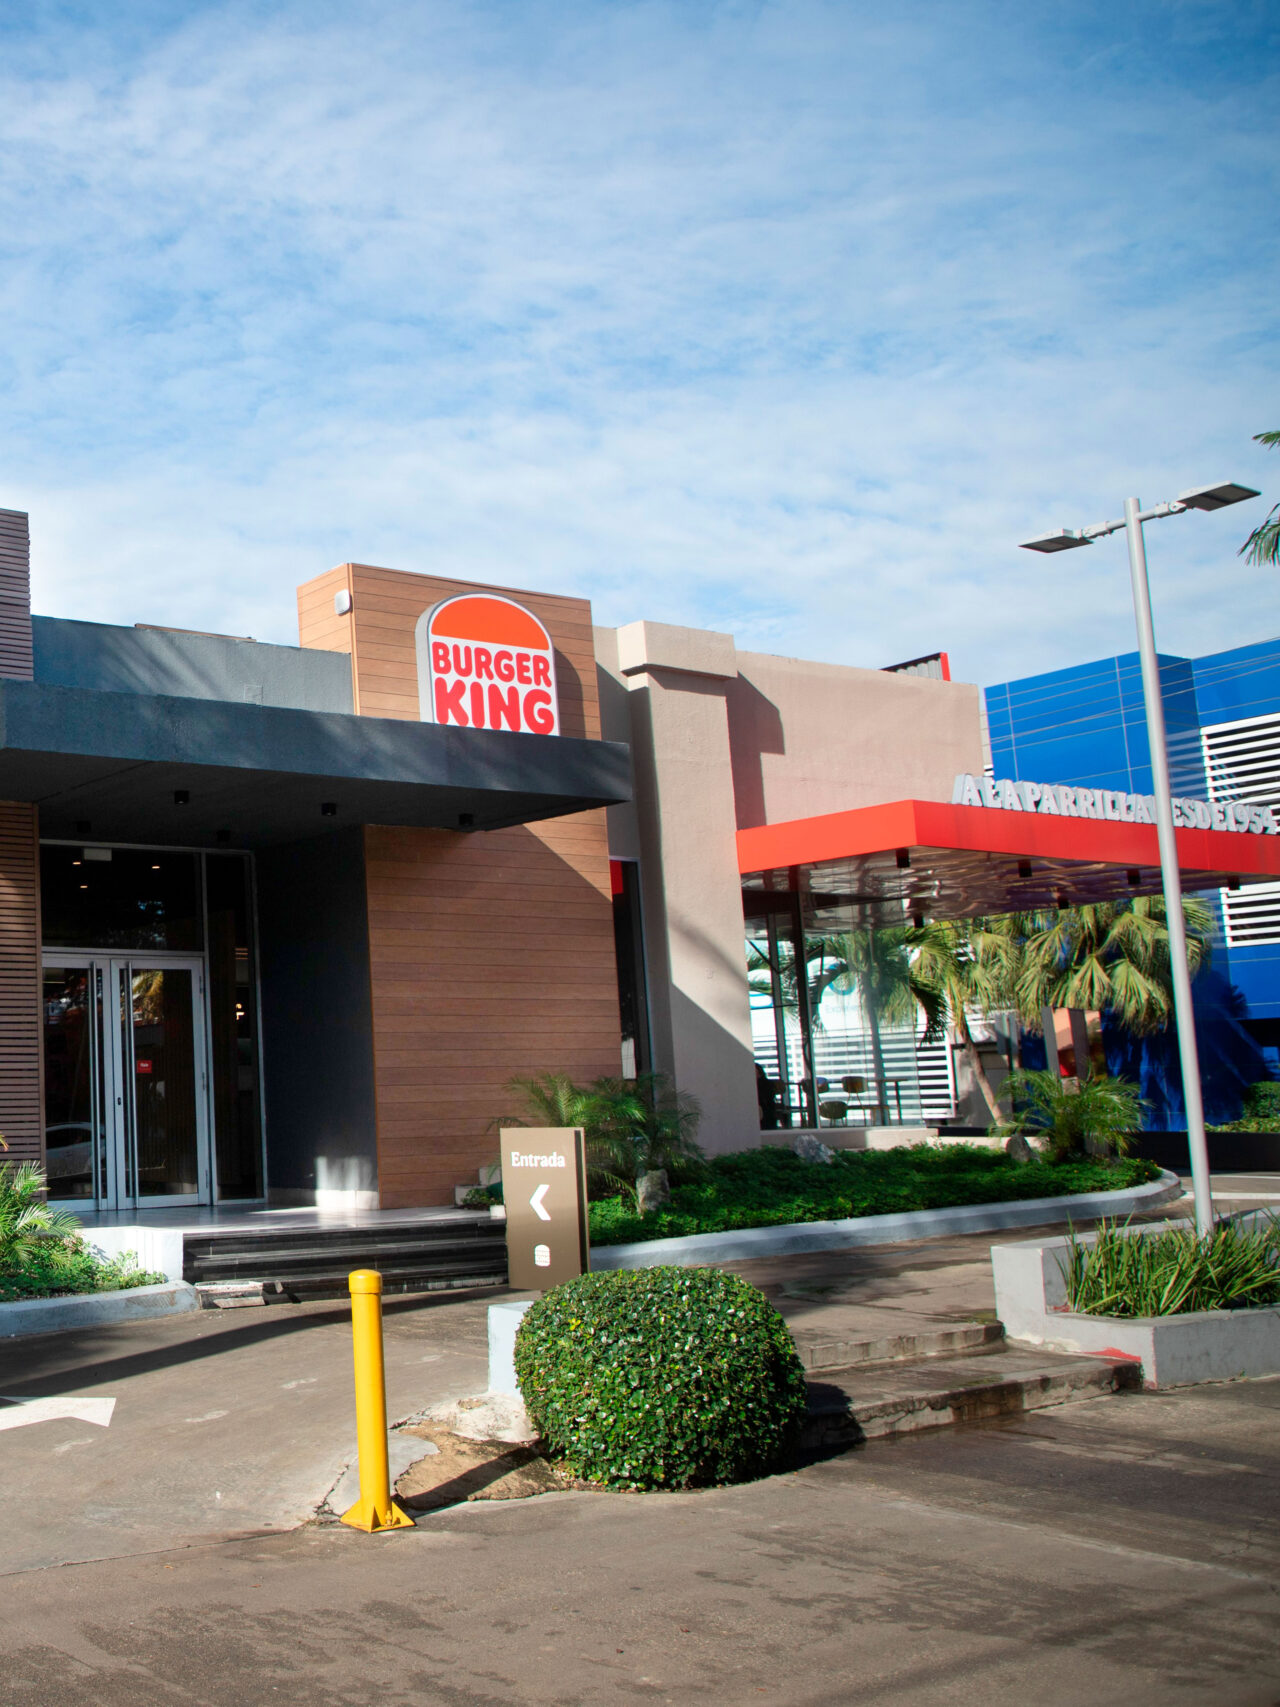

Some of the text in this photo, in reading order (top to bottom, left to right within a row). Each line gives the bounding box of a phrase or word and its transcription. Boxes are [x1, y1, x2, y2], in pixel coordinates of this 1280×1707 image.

[432, 642, 552, 688] BURGER
[434, 677, 555, 735] KING
[1020, 780, 1153, 824] PARRILLA
[511, 1151, 565, 1168] Entrada
